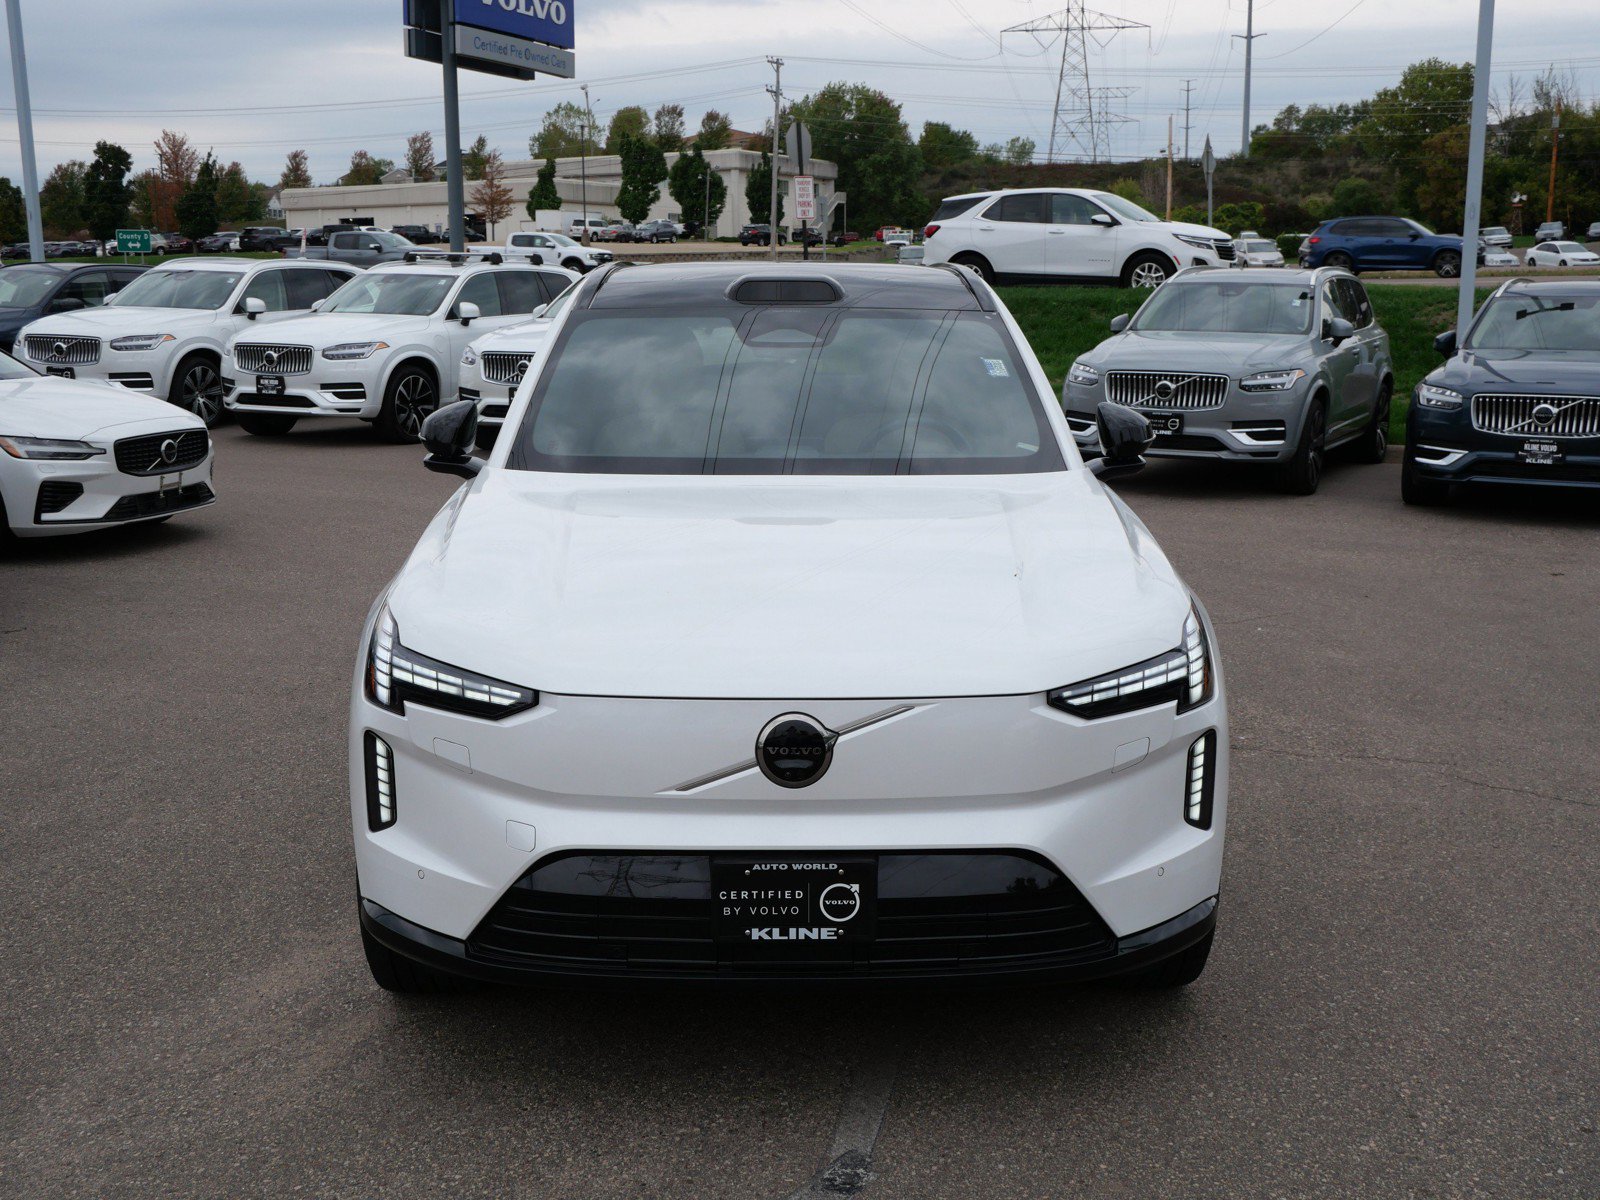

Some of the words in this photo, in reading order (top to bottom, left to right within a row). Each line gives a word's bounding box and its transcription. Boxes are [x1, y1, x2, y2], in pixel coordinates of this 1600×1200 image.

[482, 0, 566, 25] LVO
[474, 37, 507, 55] Certified
[510, 45, 522, 58] Pre
[524, 48, 549, 65] Owned
[552, 55, 566, 68] Cars
[766, 746, 822, 755] VOLVO
[752, 863, 788, 871] AUTO
[719, 890, 804, 900] CERTIFIED
[723, 907, 741, 916] BY
[750, 906, 800, 915] VOLVO
[751, 927, 838, 940] KLINE
